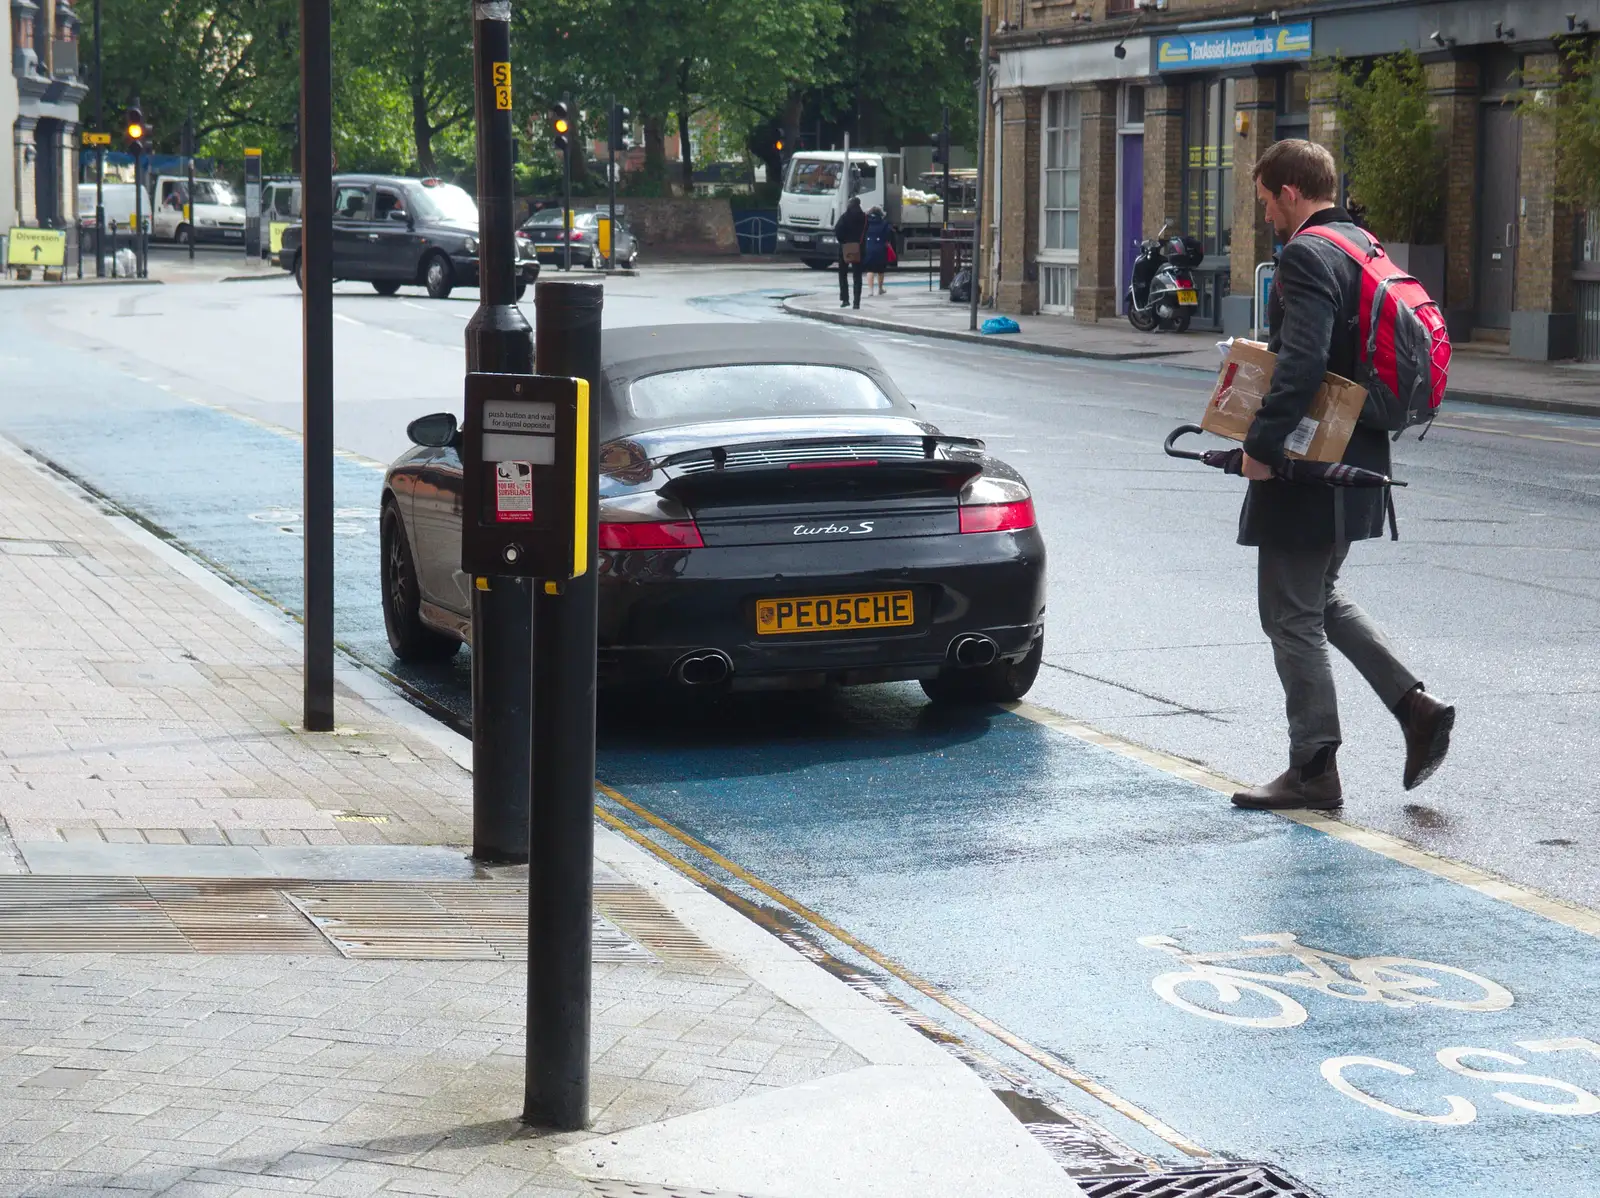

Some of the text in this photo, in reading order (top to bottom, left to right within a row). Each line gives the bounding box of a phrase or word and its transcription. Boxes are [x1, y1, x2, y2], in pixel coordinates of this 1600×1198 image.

[1190, 36, 1273, 60] TaxAssist Accountants
[496, 65, 507, 82] S
[500, 90, 508, 107] 3
[16, 232, 60, 242] Diversion
[488, 411, 504, 419] push
[505, 411, 526, 419] button
[528, 412, 539, 420] and
[502, 419, 521, 428] signal
[523, 421, 551, 429] opposite
[793, 524, 849, 536] turbo
